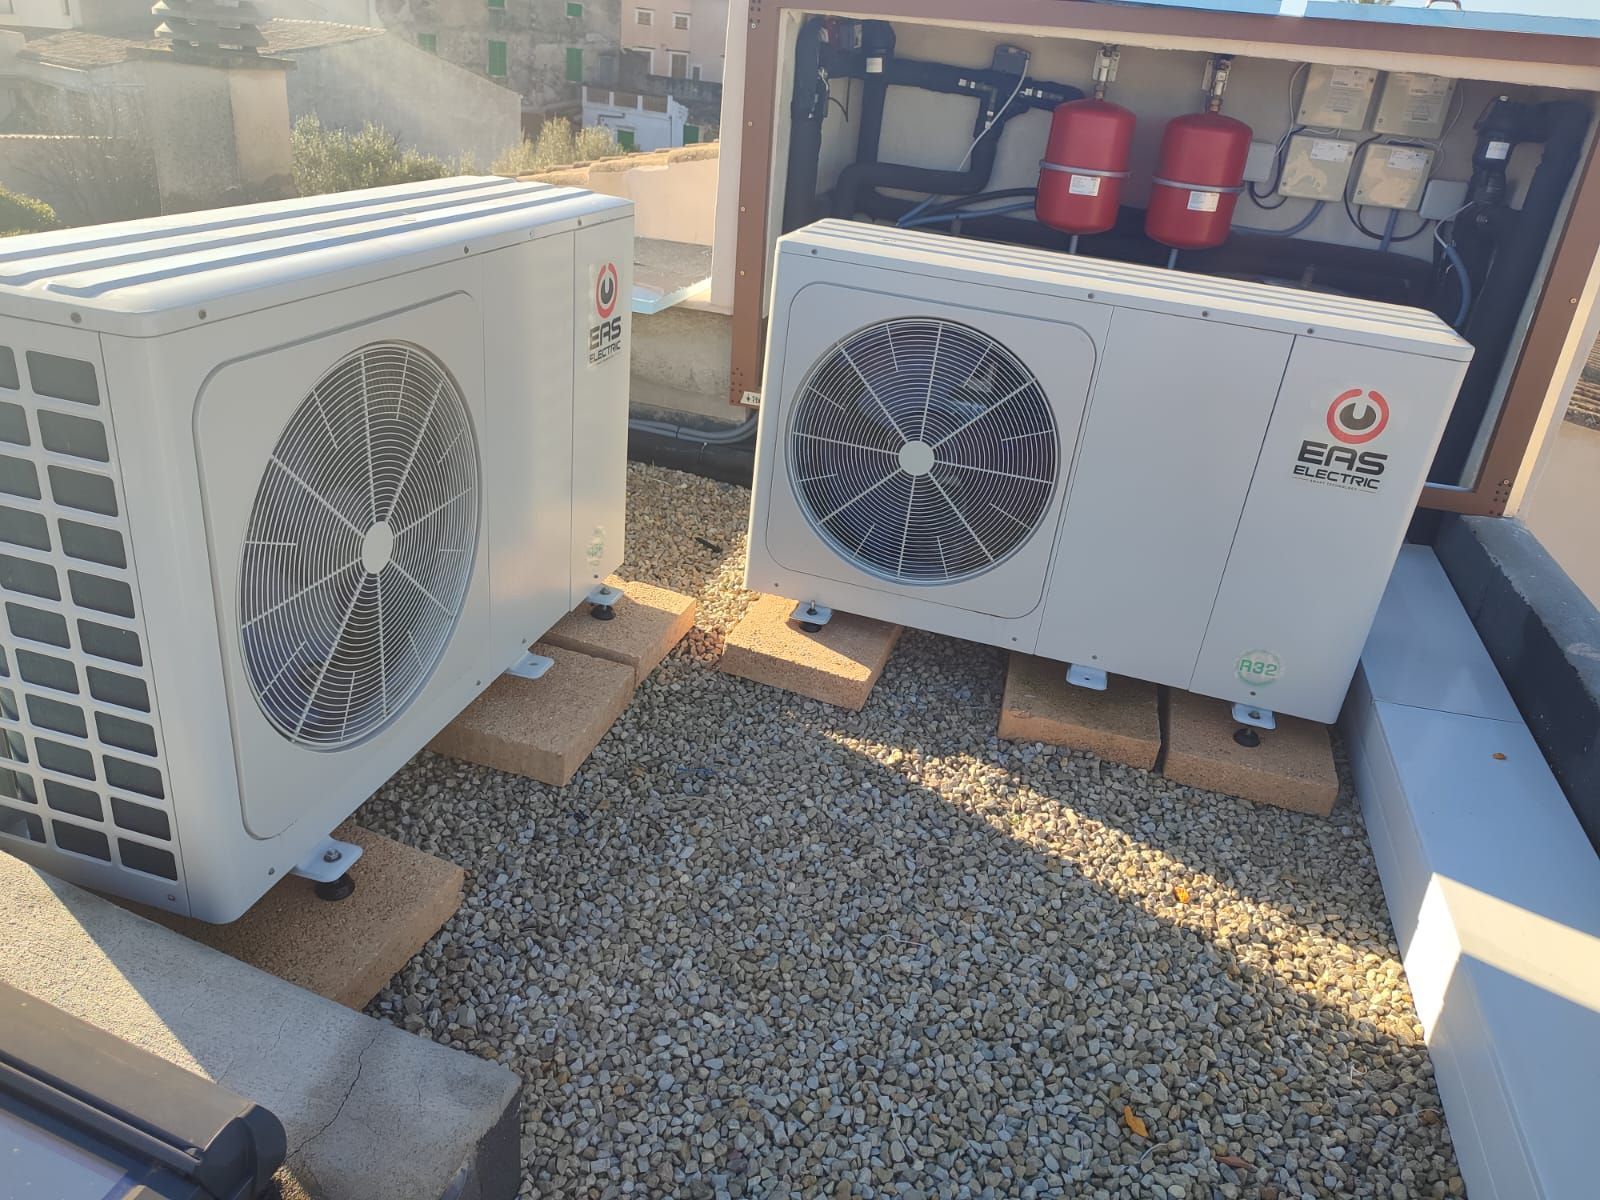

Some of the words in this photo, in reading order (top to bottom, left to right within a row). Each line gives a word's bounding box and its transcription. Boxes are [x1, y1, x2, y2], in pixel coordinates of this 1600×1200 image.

[589, 316, 621, 350] EAS
[589, 340, 621, 364] ELECTRIC
[1297, 440, 1388, 476] EAS
[1293, 464, 1381, 490] ELECTRIC
[1239, 659, 1278, 677] R32
